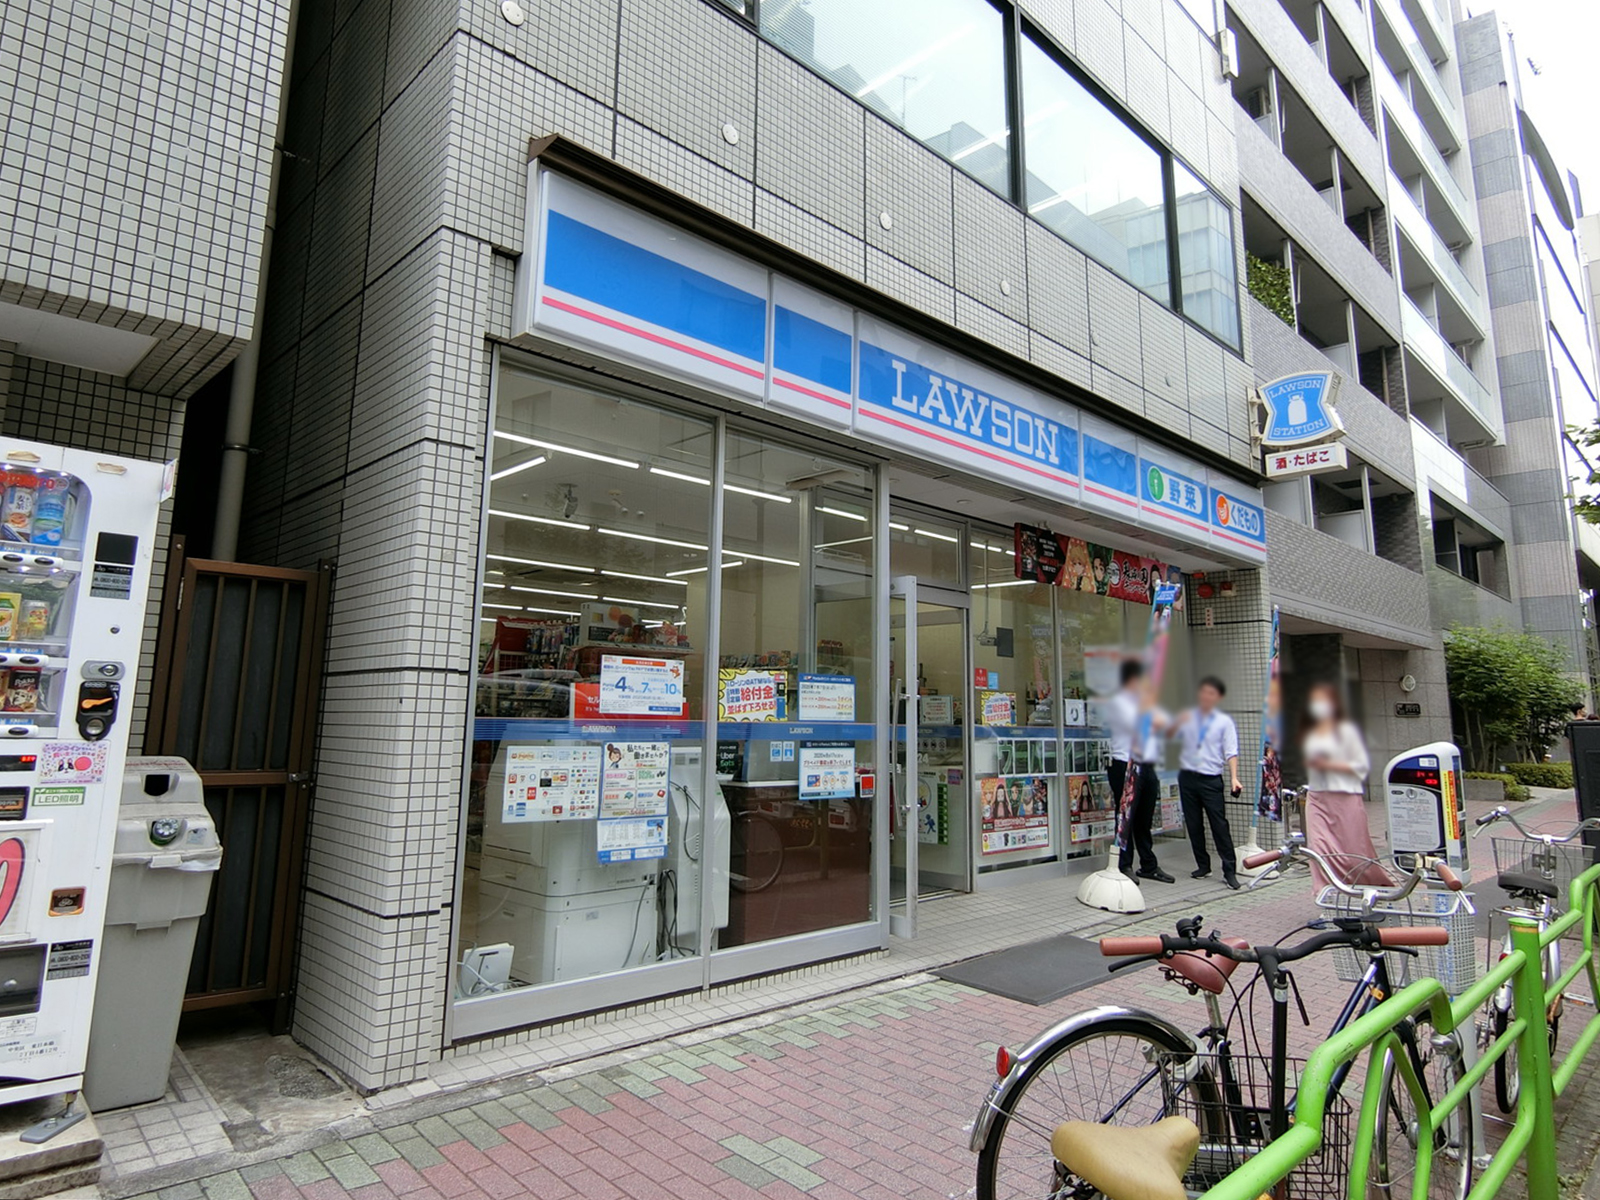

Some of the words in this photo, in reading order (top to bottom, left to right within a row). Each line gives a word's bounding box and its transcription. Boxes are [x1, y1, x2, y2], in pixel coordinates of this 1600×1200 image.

[1269, 379, 1322, 398] LAWSON
[891, 359, 1059, 465] LAWSON
[1273, 419, 1325, 436] STATION
[1275, 450, 1330, 470] 酒・たばこ
[1168, 477, 1197, 510] 野菜
[1230, 504, 1258, 533] くだもの
[740, 685, 774, 702] 給付金
[38, 794, 80, 804] LED照明
